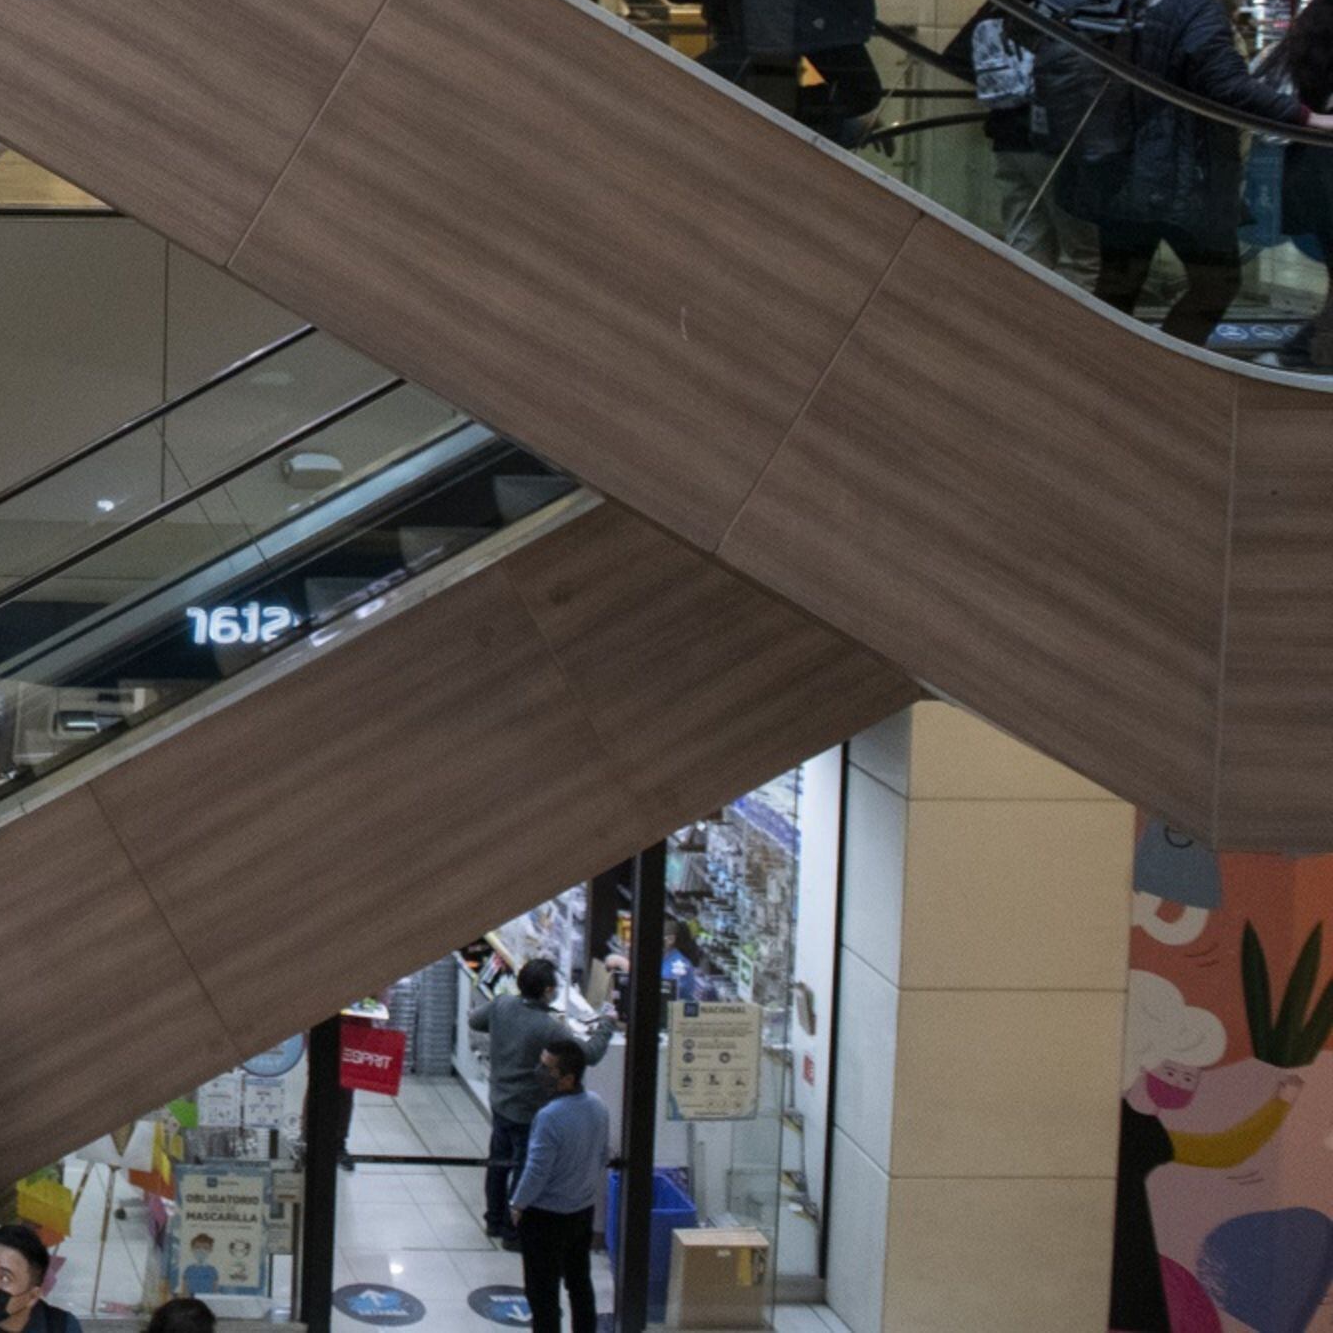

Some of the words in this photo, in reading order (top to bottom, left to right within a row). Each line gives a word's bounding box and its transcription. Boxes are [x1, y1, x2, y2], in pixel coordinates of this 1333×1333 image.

[342, 1047, 394, 1070] ESPRIT
[185, 1194, 260, 1205] OBLIGATORIO
[186, 1212, 258, 1223] MASCARILLA
